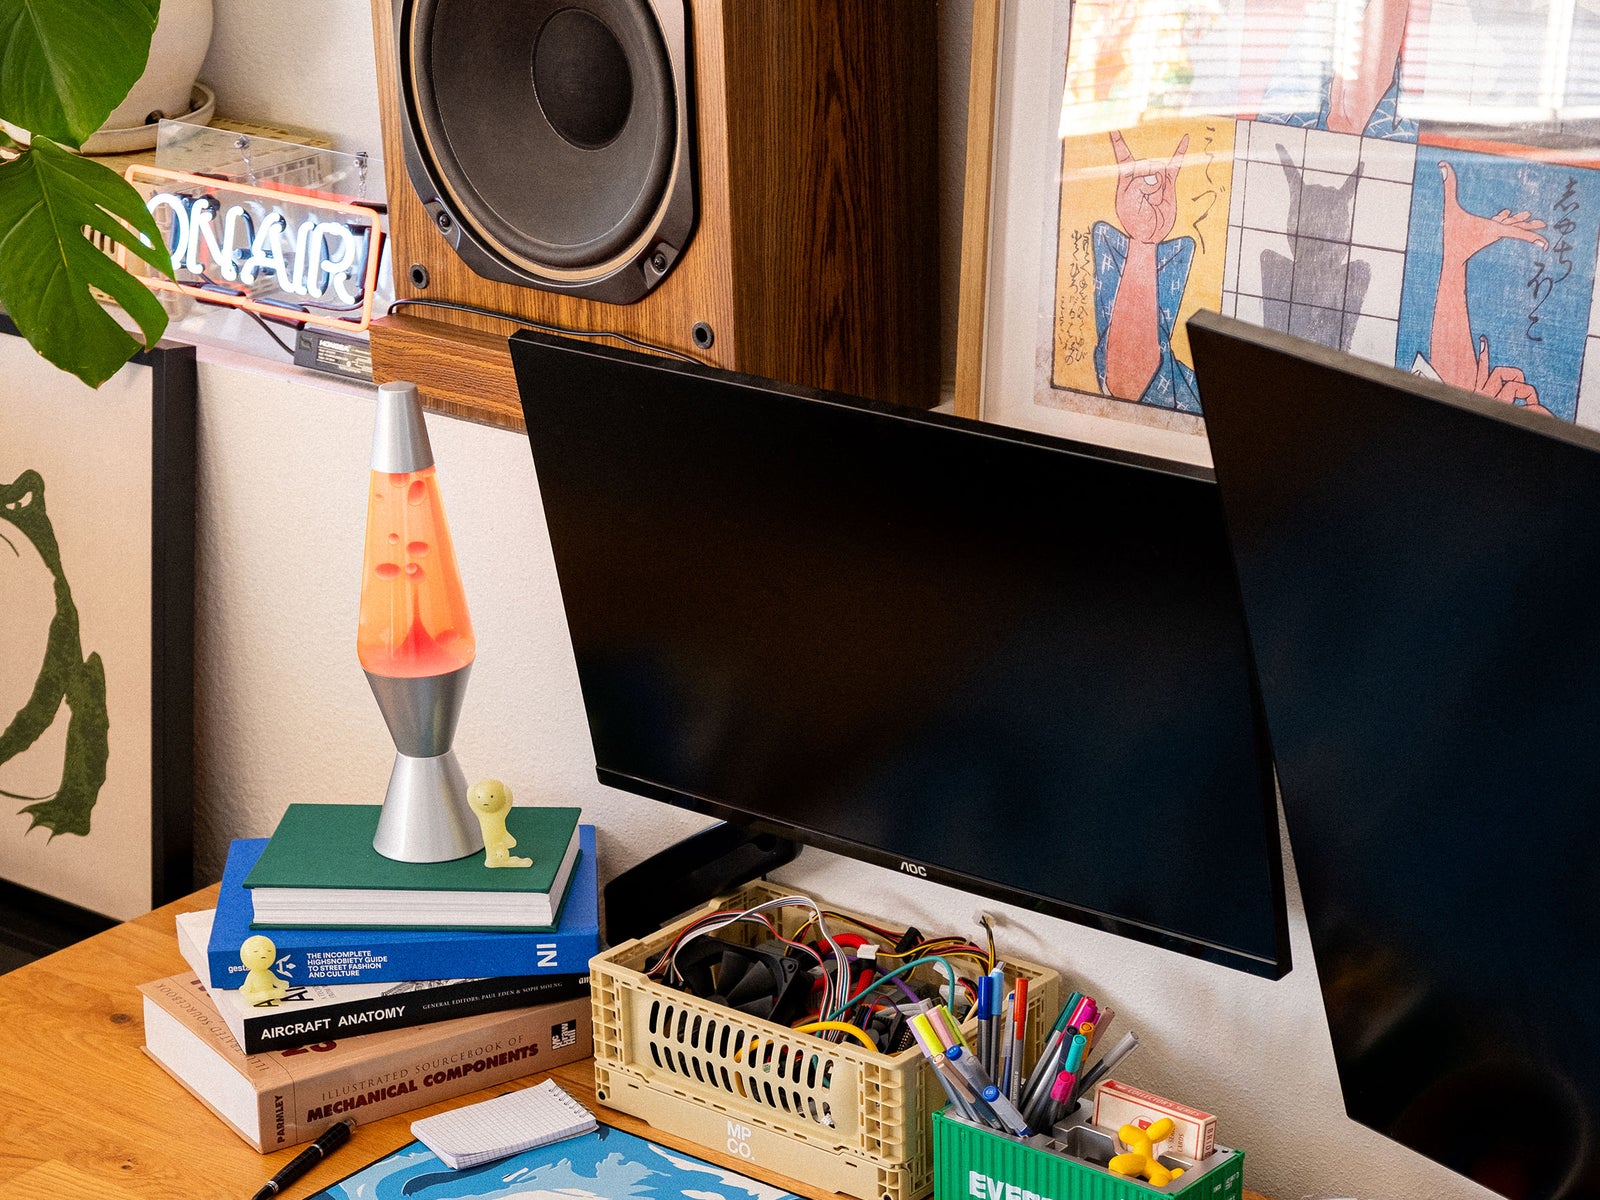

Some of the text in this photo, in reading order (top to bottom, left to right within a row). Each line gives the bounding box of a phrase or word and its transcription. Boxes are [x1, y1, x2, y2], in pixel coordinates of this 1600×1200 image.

[139, 193, 356, 305] ON AIR
[901, 861, 927, 877] AOC
[306, 950, 371, 960] THE INCOMPLETE
[307, 955, 388, 966] HIGHSNOBIETY GUIDE
[326, 970, 360, 978] CULTURE
[422, 1000, 451, 1010] GENERAL
[498, 989, 515, 998] EDEN
[260, 1006, 406, 1041] AIRCRAFT ANATOMY
[322, 1034, 525, 1101] ILLUSTRATED SOURCEBOOK OF
[306, 1043, 540, 1123] MECHANICAL COMPONENTS
[274, 1095, 285, 1144] PARMLEY
[726, 1120, 752, 1141] MP
[726, 1138, 755, 1161] CO.
